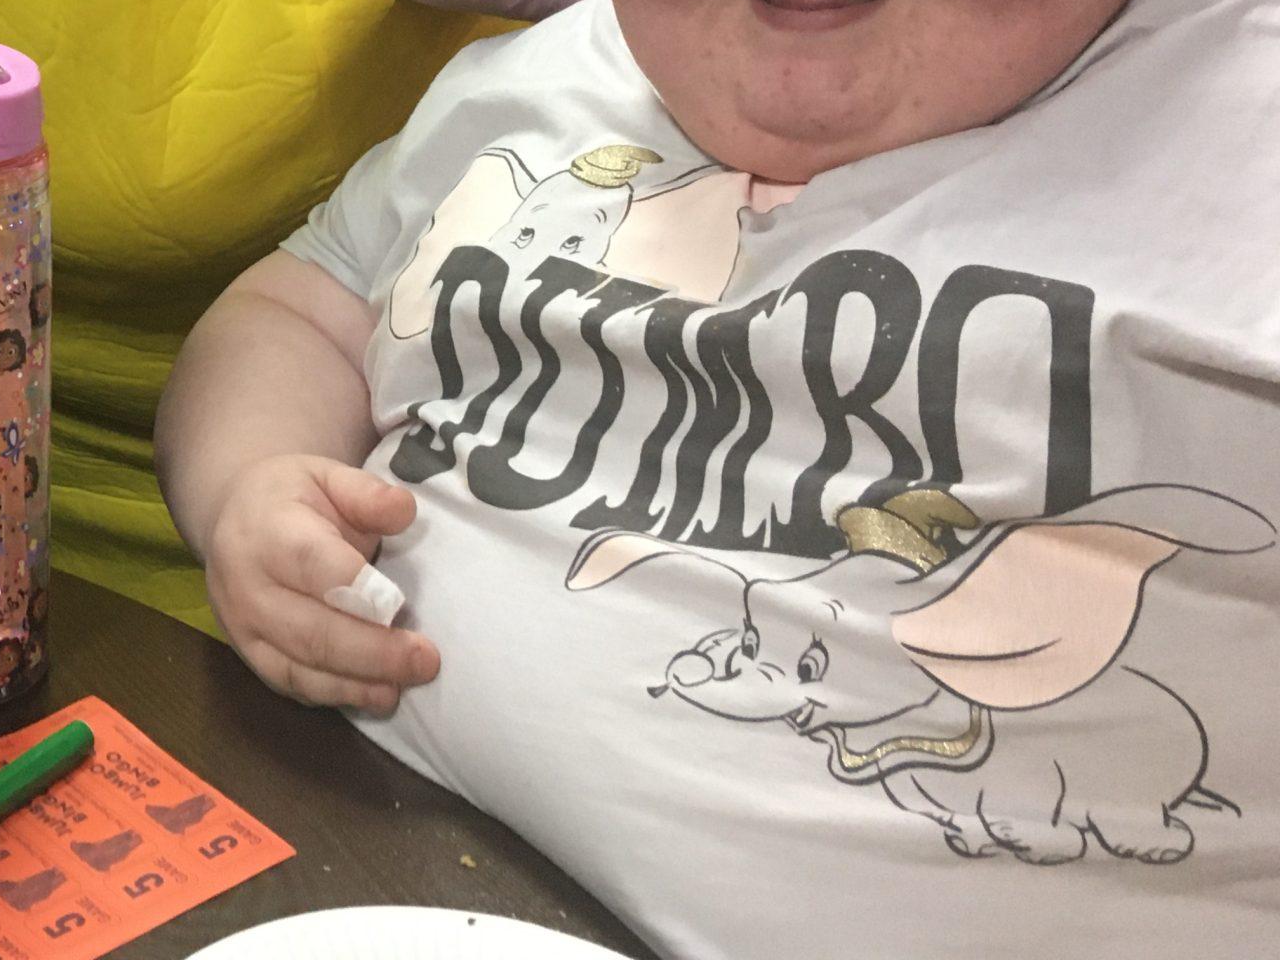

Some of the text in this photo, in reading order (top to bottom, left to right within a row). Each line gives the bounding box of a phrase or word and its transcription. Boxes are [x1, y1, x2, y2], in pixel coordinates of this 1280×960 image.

[388, 244, 1095, 570] DUMBO
[90, 763, 146, 800] JUMBO
[106, 751, 160, 788] BINGO
[30, 803, 72, 837] JUMB
[43, 793, 87, 823] BING
[198, 834, 238, 860] 5
[123, 872, 164, 899] 5
[43, 912, 85, 939] 5
